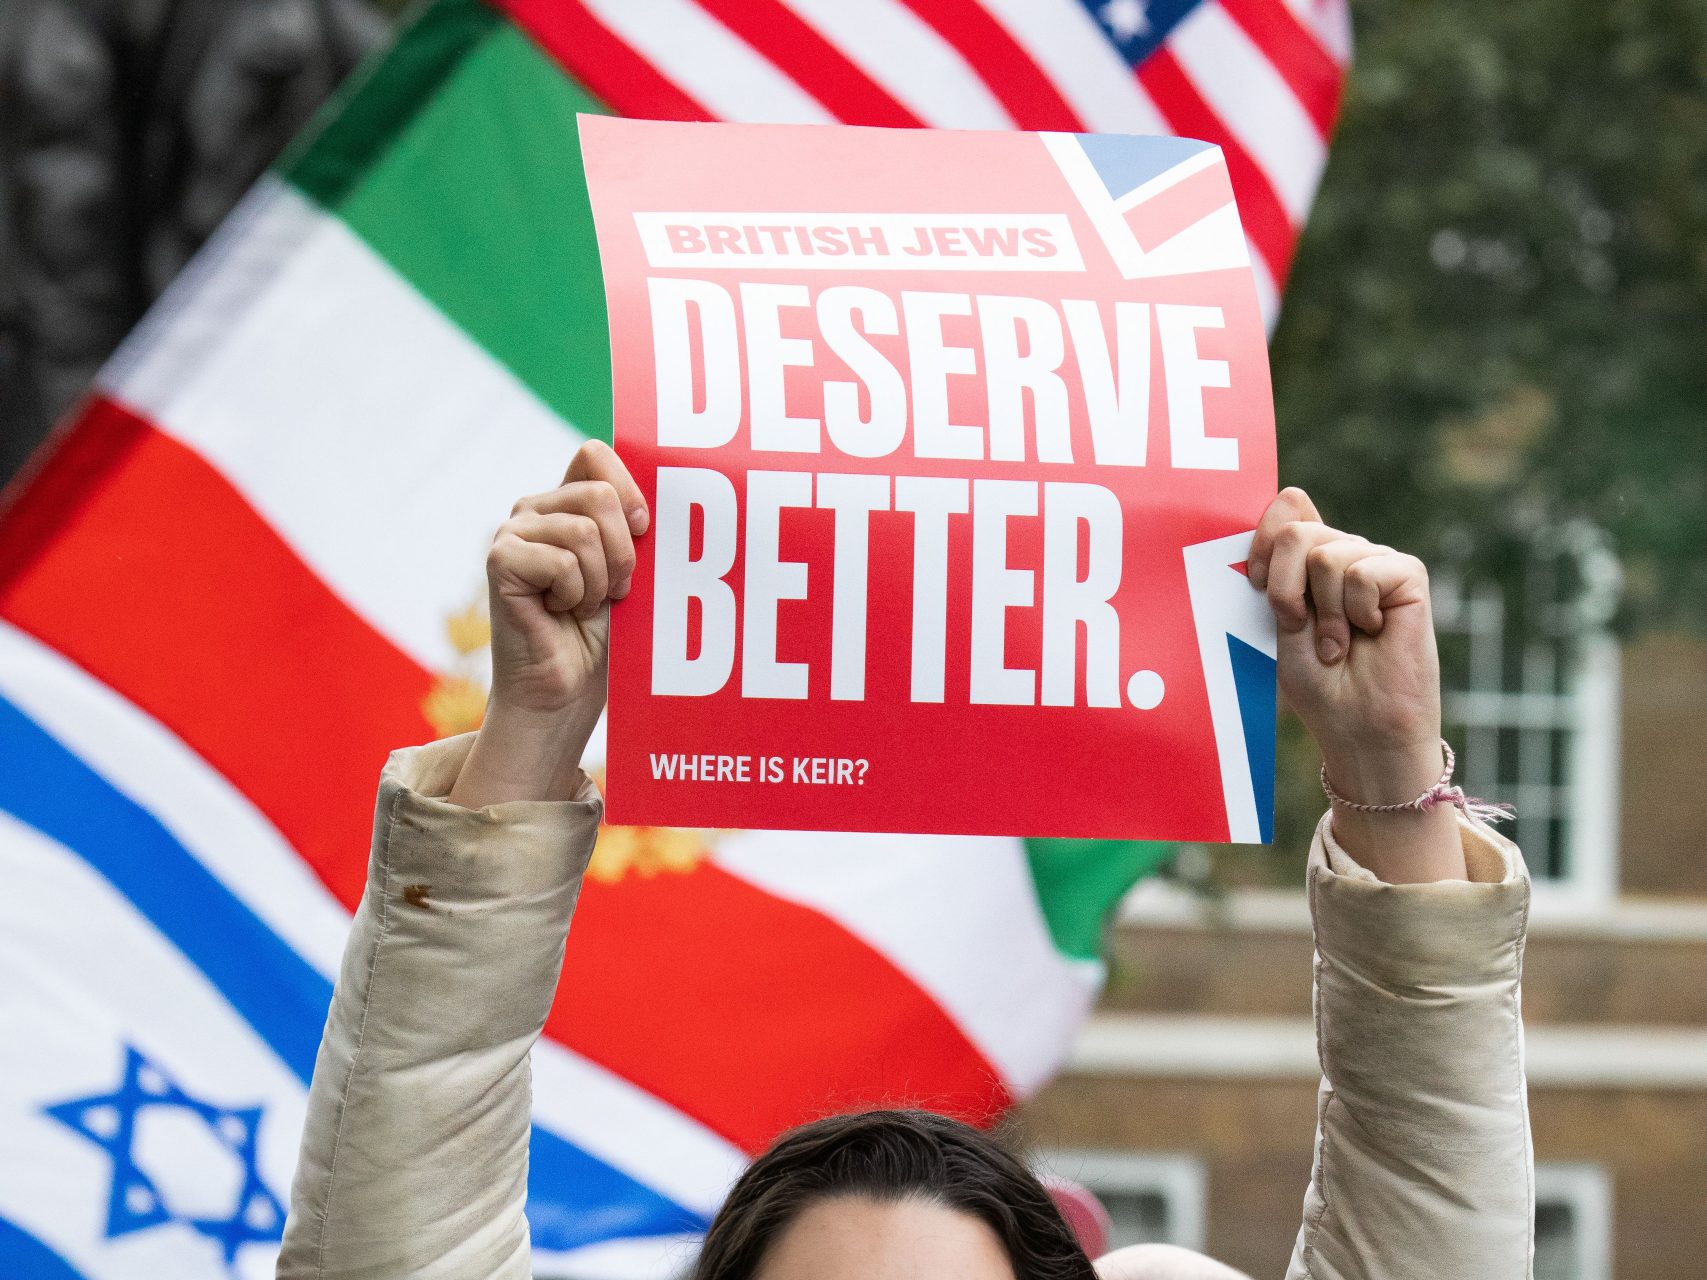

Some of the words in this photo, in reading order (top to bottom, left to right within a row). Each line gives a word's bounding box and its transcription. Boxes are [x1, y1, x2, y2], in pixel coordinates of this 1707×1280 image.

[665, 223, 889, 257] BRITISH
[903, 225, 1057, 259] JEWS
[647, 277, 1240, 471] DESERVE
[650, 466, 1165, 711] BETTER.
[650, 754, 751, 782] WHERE
[759, 757, 784, 784] IS
[792, 757, 869, 785] KEIR?
